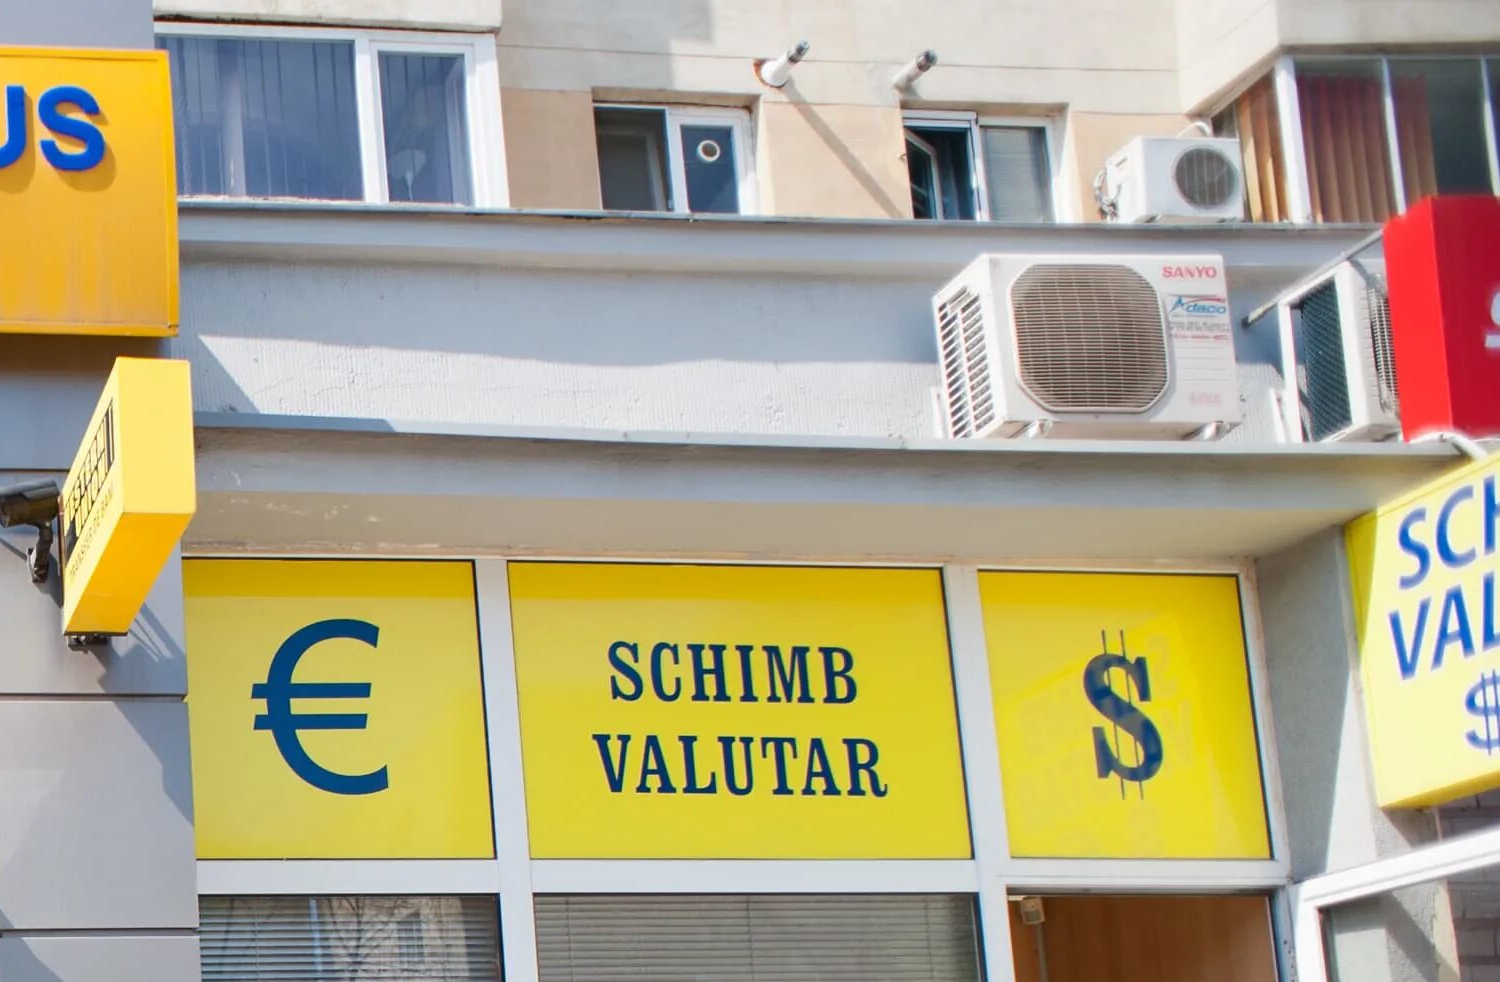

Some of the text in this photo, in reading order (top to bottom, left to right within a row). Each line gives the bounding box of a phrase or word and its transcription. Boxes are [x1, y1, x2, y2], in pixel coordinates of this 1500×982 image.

[1162, 266, 1217, 278] SANYO
[607, 641, 857, 704] SCHIMB
[250, 619, 389, 796] €
[1083, 629, 1163, 800] $
[591, 734, 889, 799] VALUTAR
